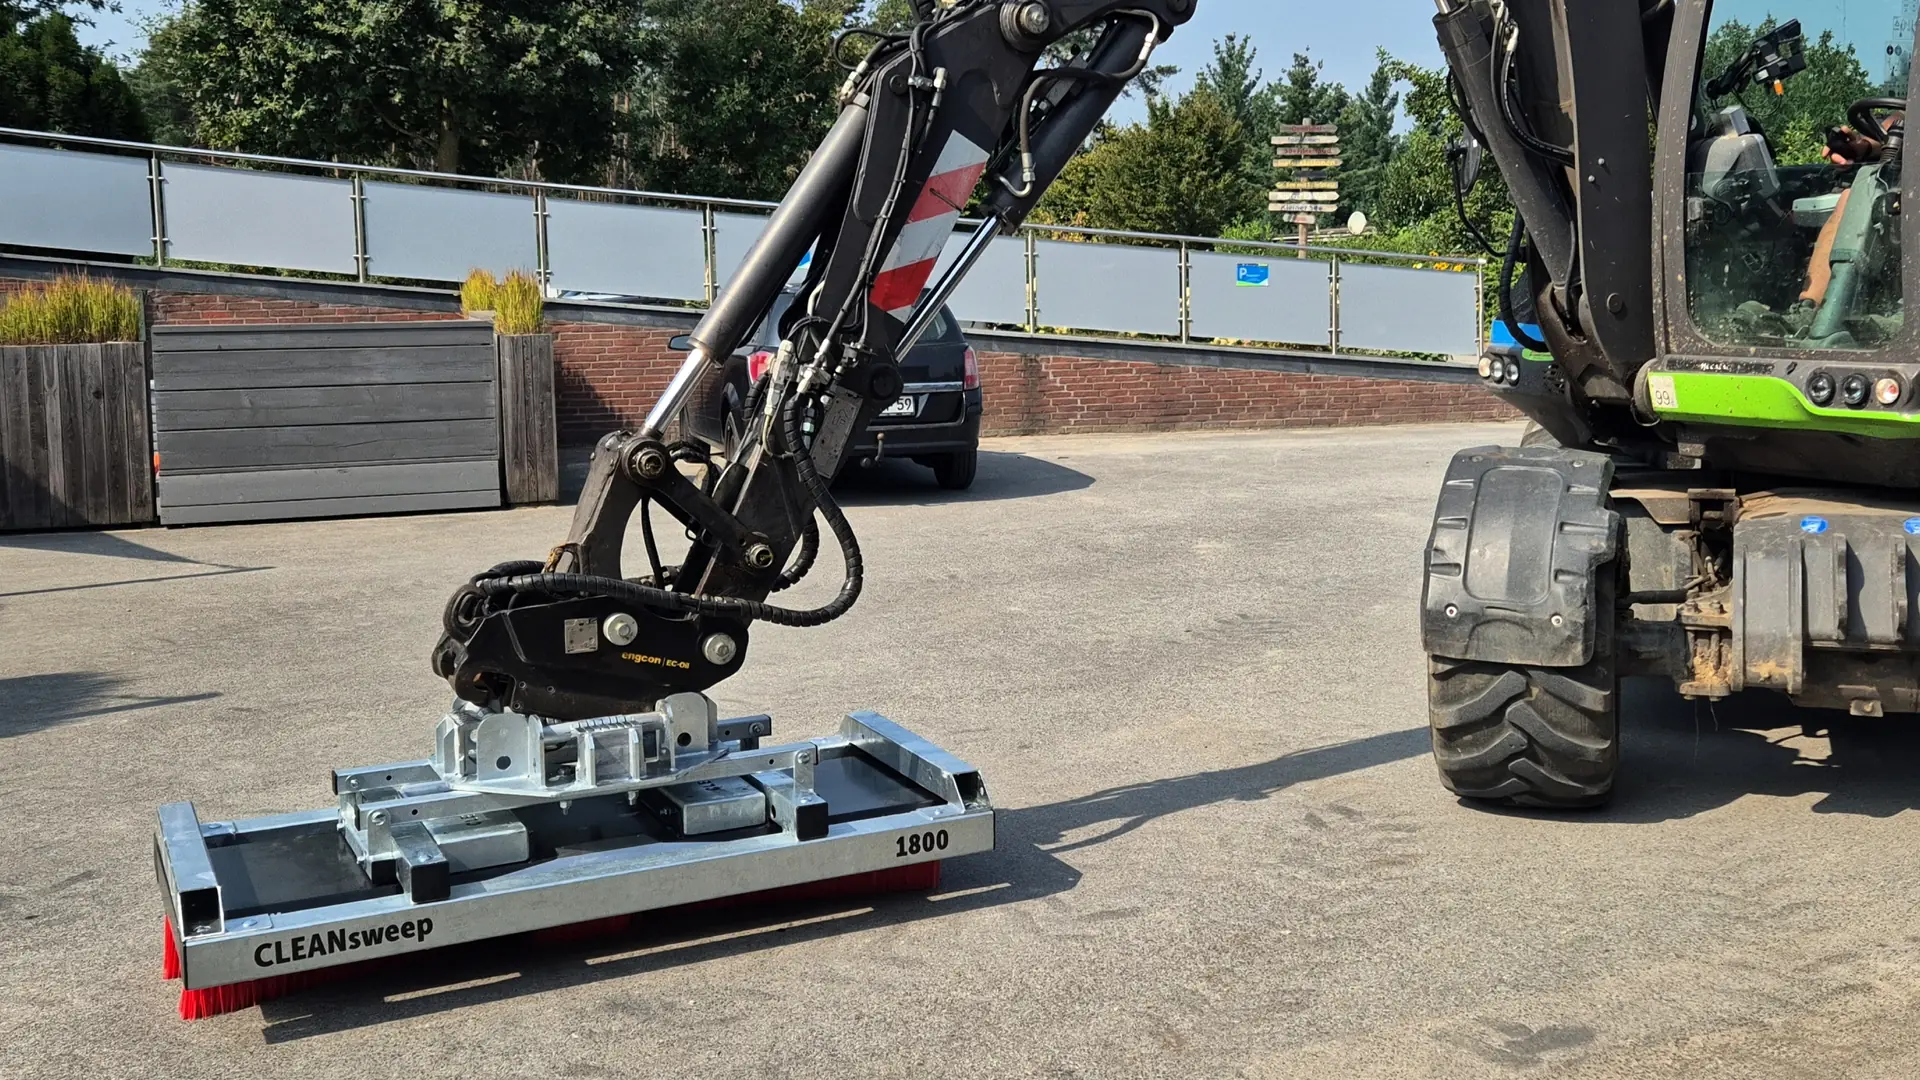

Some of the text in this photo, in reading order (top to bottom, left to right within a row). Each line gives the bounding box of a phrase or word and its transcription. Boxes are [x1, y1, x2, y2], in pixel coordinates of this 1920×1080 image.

[1239, 267, 1248, 280] P
[896, 397, 912, 411] 59
[1655, 390, 1670, 405] 99
[621, 651, 661, 664] engcon
[896, 829, 949, 858] 1800
[254, 917, 434, 968] CLEANsweep
